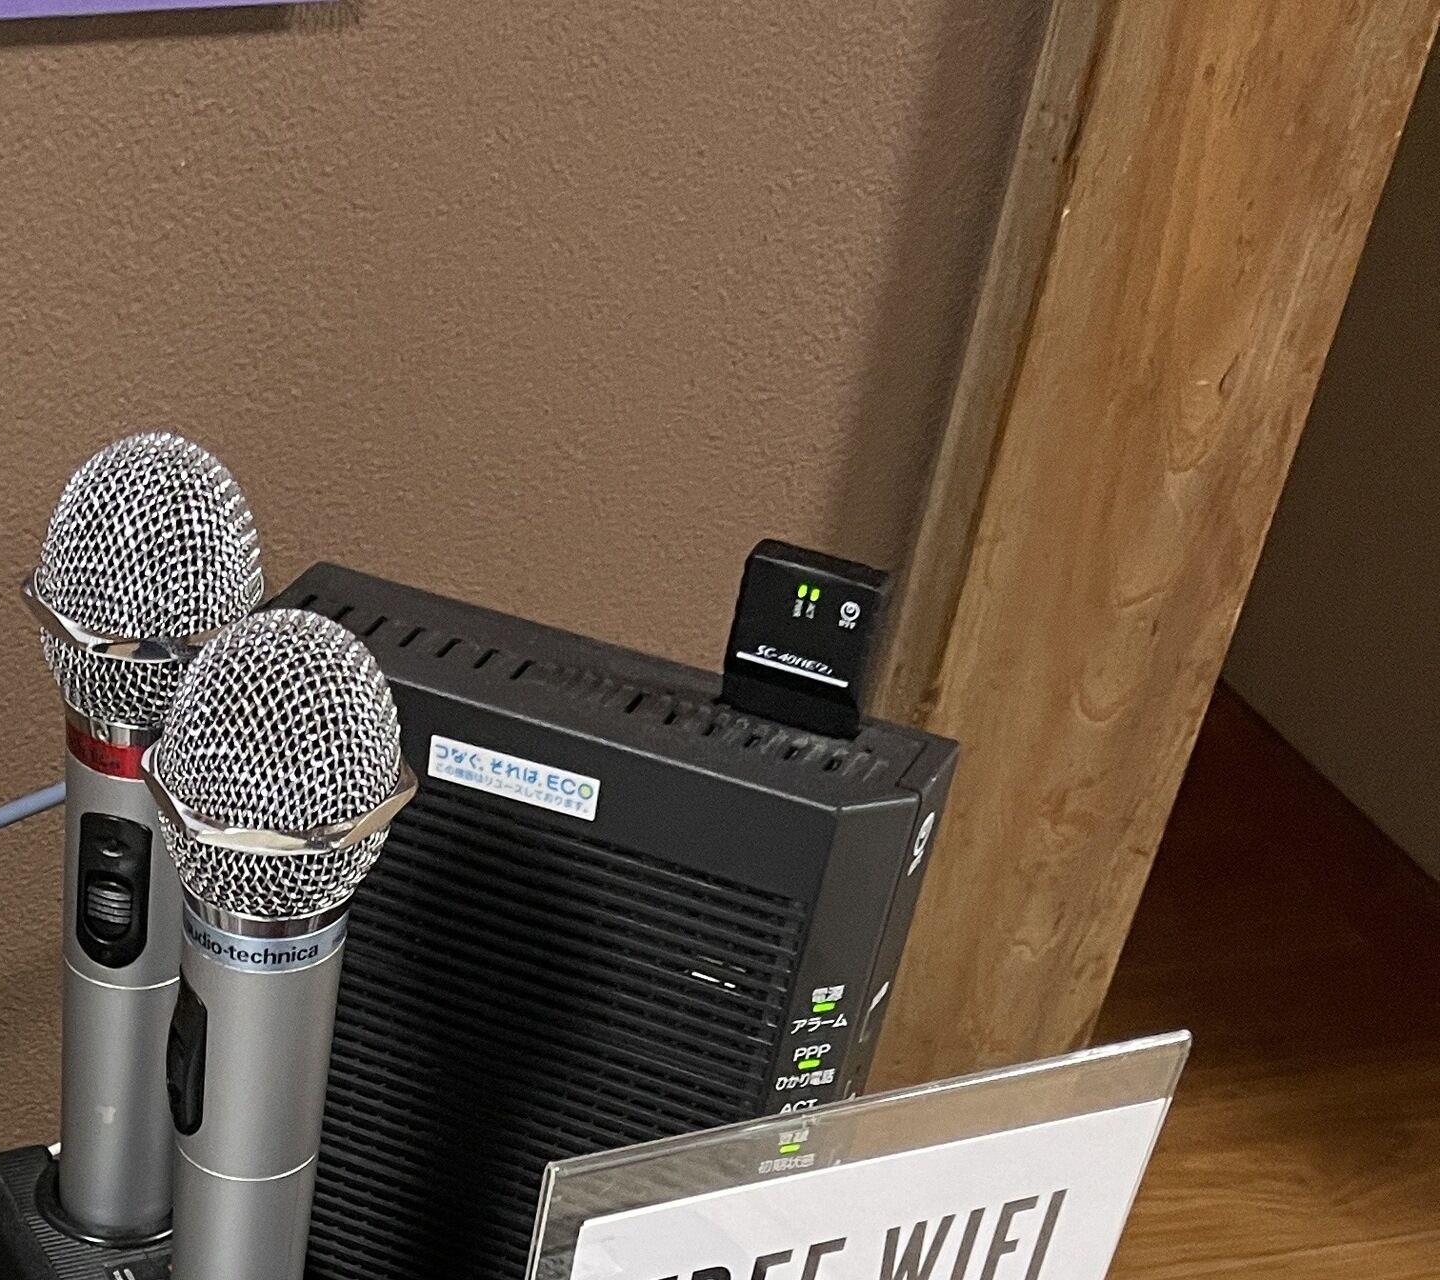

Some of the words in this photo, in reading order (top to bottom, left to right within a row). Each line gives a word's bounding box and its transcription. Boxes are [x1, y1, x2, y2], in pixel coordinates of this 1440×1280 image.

[790, 1012, 848, 1034] アラーム
[793, 1043, 831, 1062] PPP
[775, 1068, 836, 1091] ひかり電話
